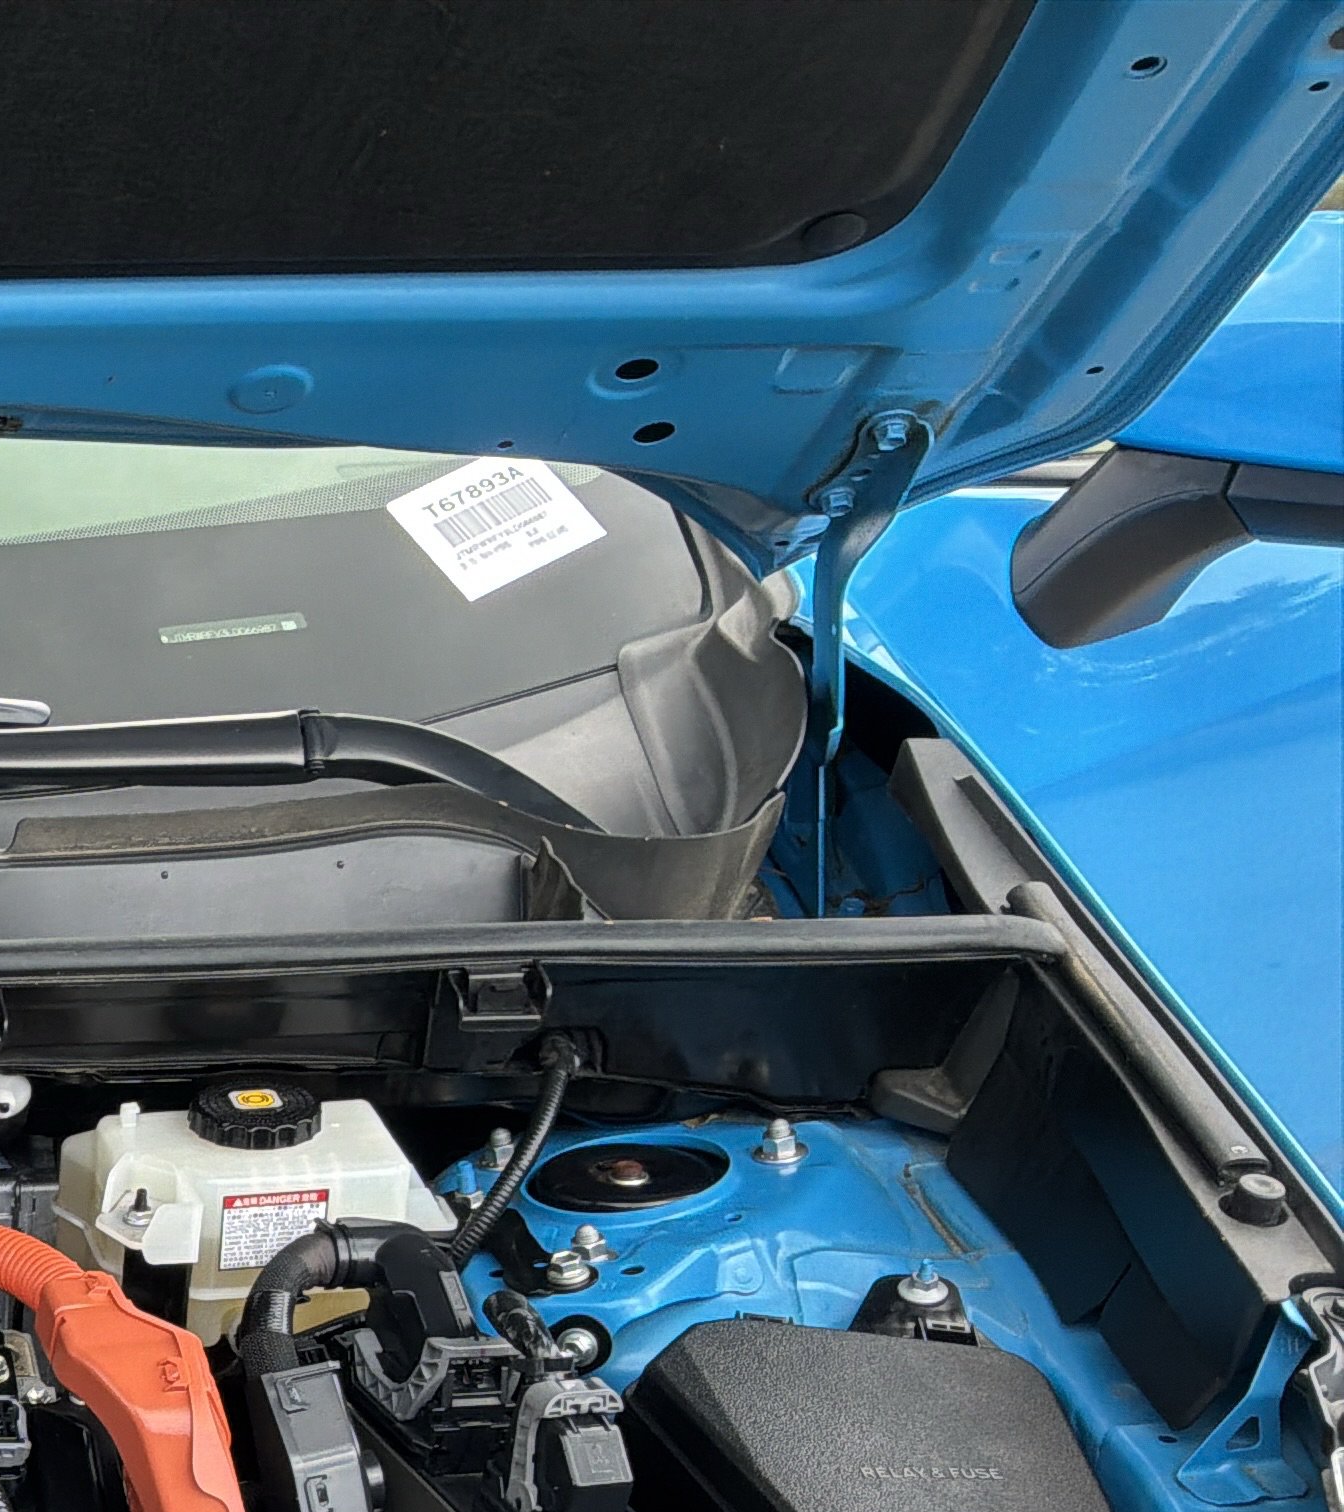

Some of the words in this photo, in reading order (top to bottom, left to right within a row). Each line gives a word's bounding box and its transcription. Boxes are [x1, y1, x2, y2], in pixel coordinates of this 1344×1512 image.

[422, 466, 524, 518] T67893A
[259, 1193, 301, 1206] DANGER
[861, 1466, 925, 1479] RELAY
[931, 1466, 945, 1478] &
[949, 1467, 1004, 1480] FUSE
